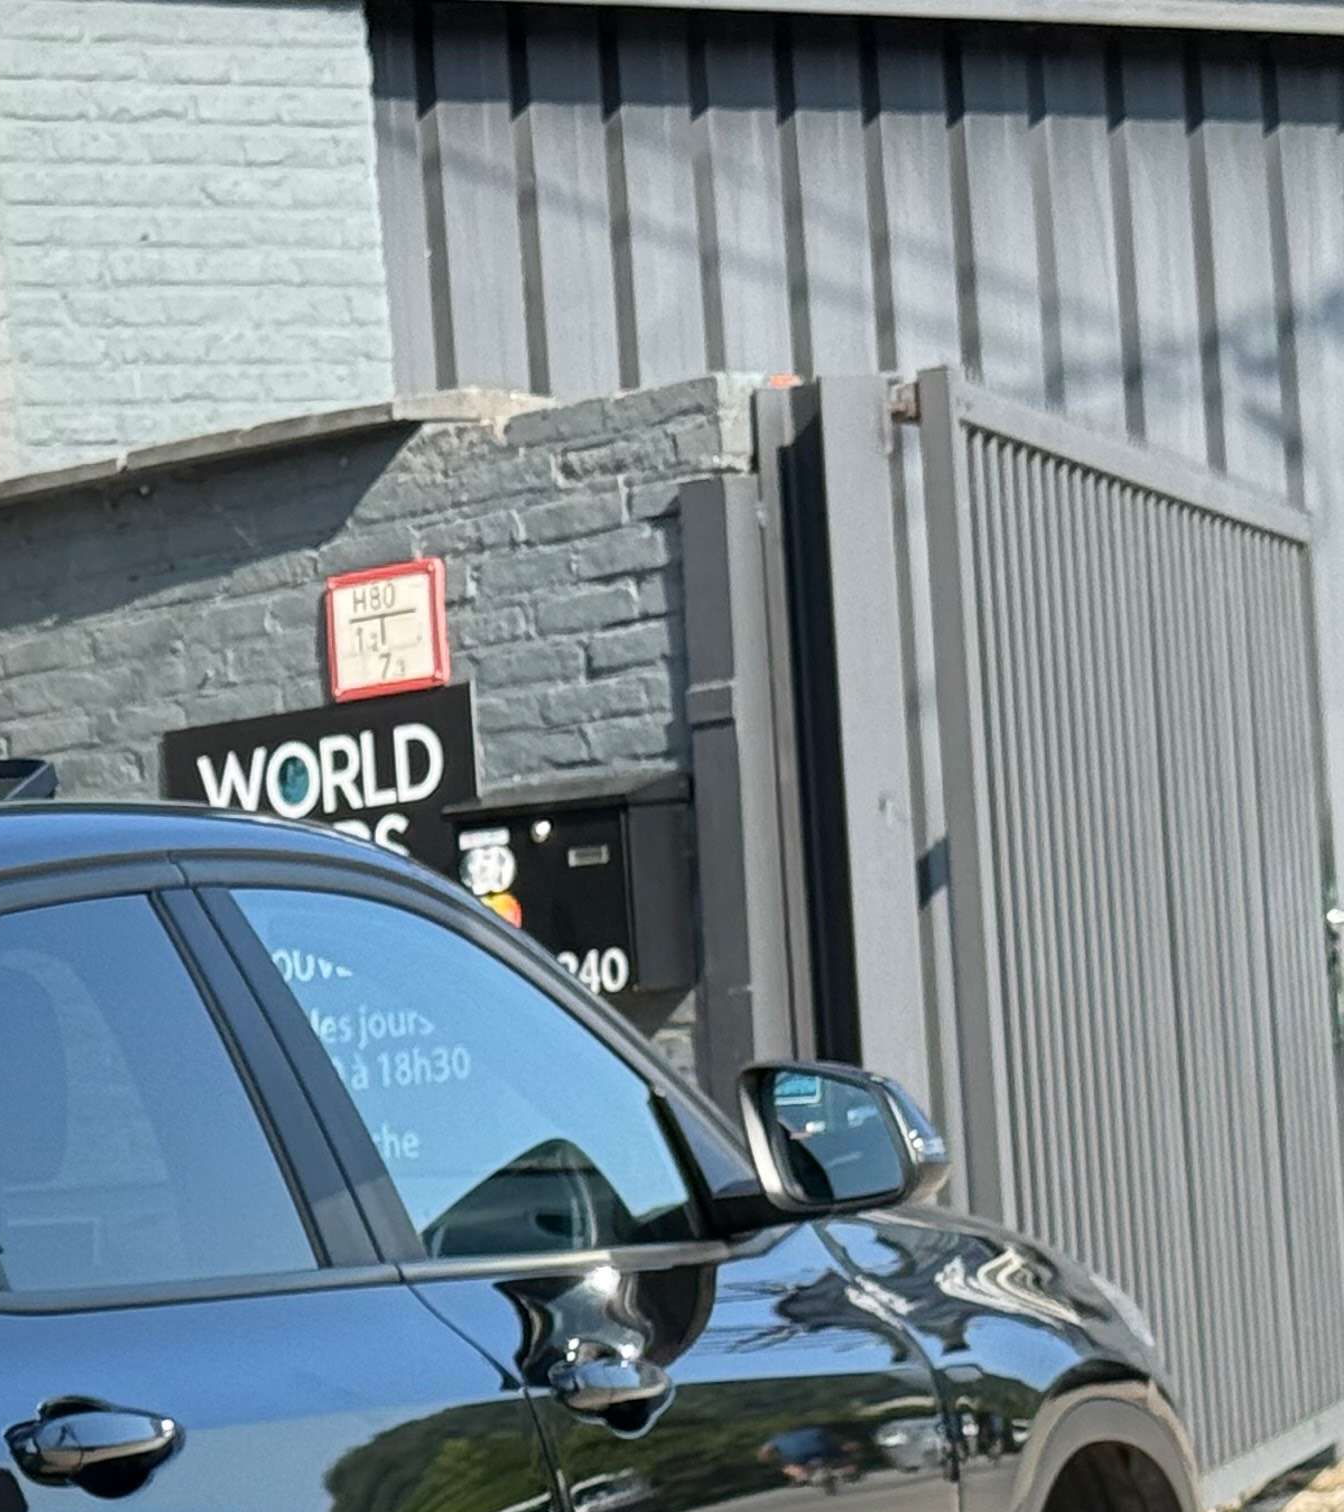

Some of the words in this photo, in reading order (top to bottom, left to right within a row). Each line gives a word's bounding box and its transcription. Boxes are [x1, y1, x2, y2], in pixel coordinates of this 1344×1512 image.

[196, 722, 444, 820] WORLD
[357, 1003, 435, 1050] jours
[377, 1042, 472, 1089] 18h30
